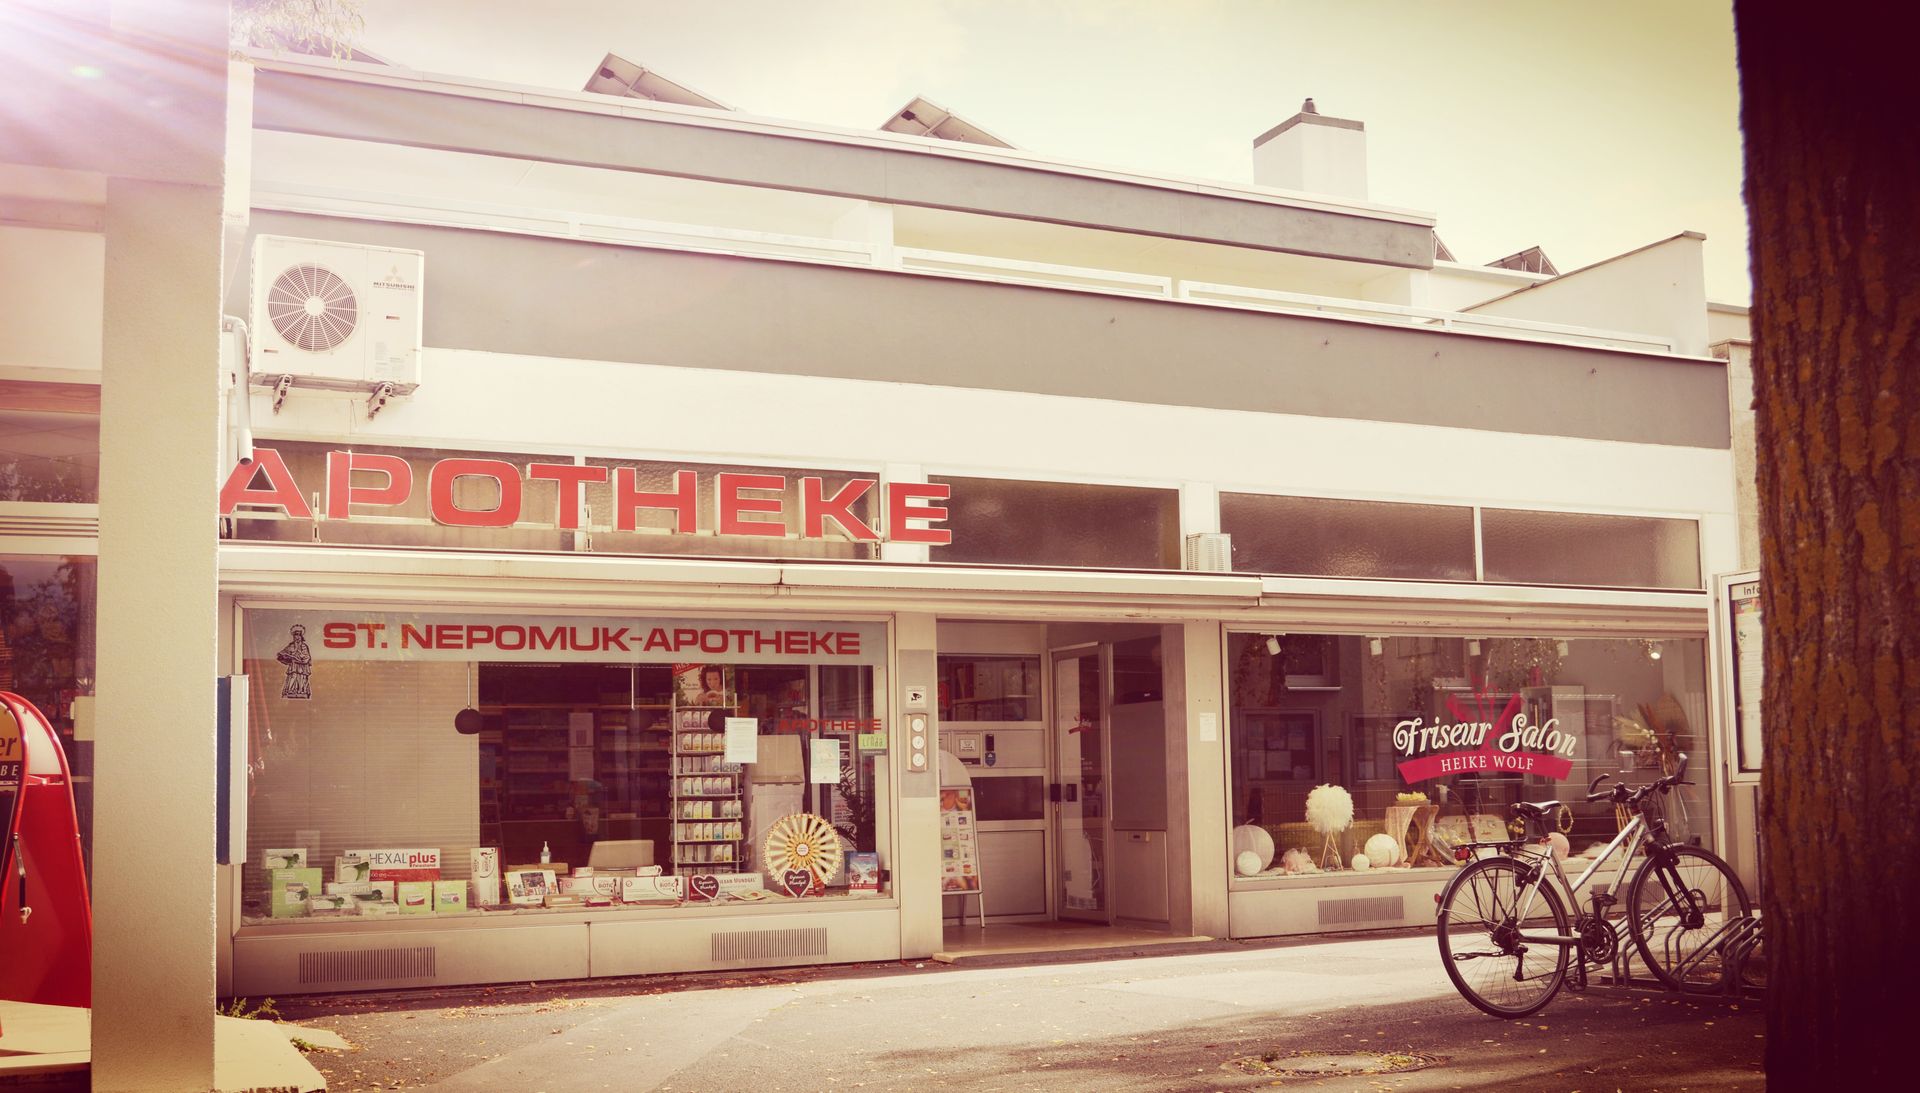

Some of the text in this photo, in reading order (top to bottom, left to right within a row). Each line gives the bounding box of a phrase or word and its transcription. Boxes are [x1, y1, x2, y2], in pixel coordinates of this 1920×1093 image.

[221, 447, 952, 545] APOTHEKE
[323, 621, 860, 655] ST. NEPOMUK-APOTHEKE
[1392, 713, 1577, 757] Friseur Salon
[1441, 756, 1534, 772] HEIKE WOLF
[409, 852, 437, 868] plus
